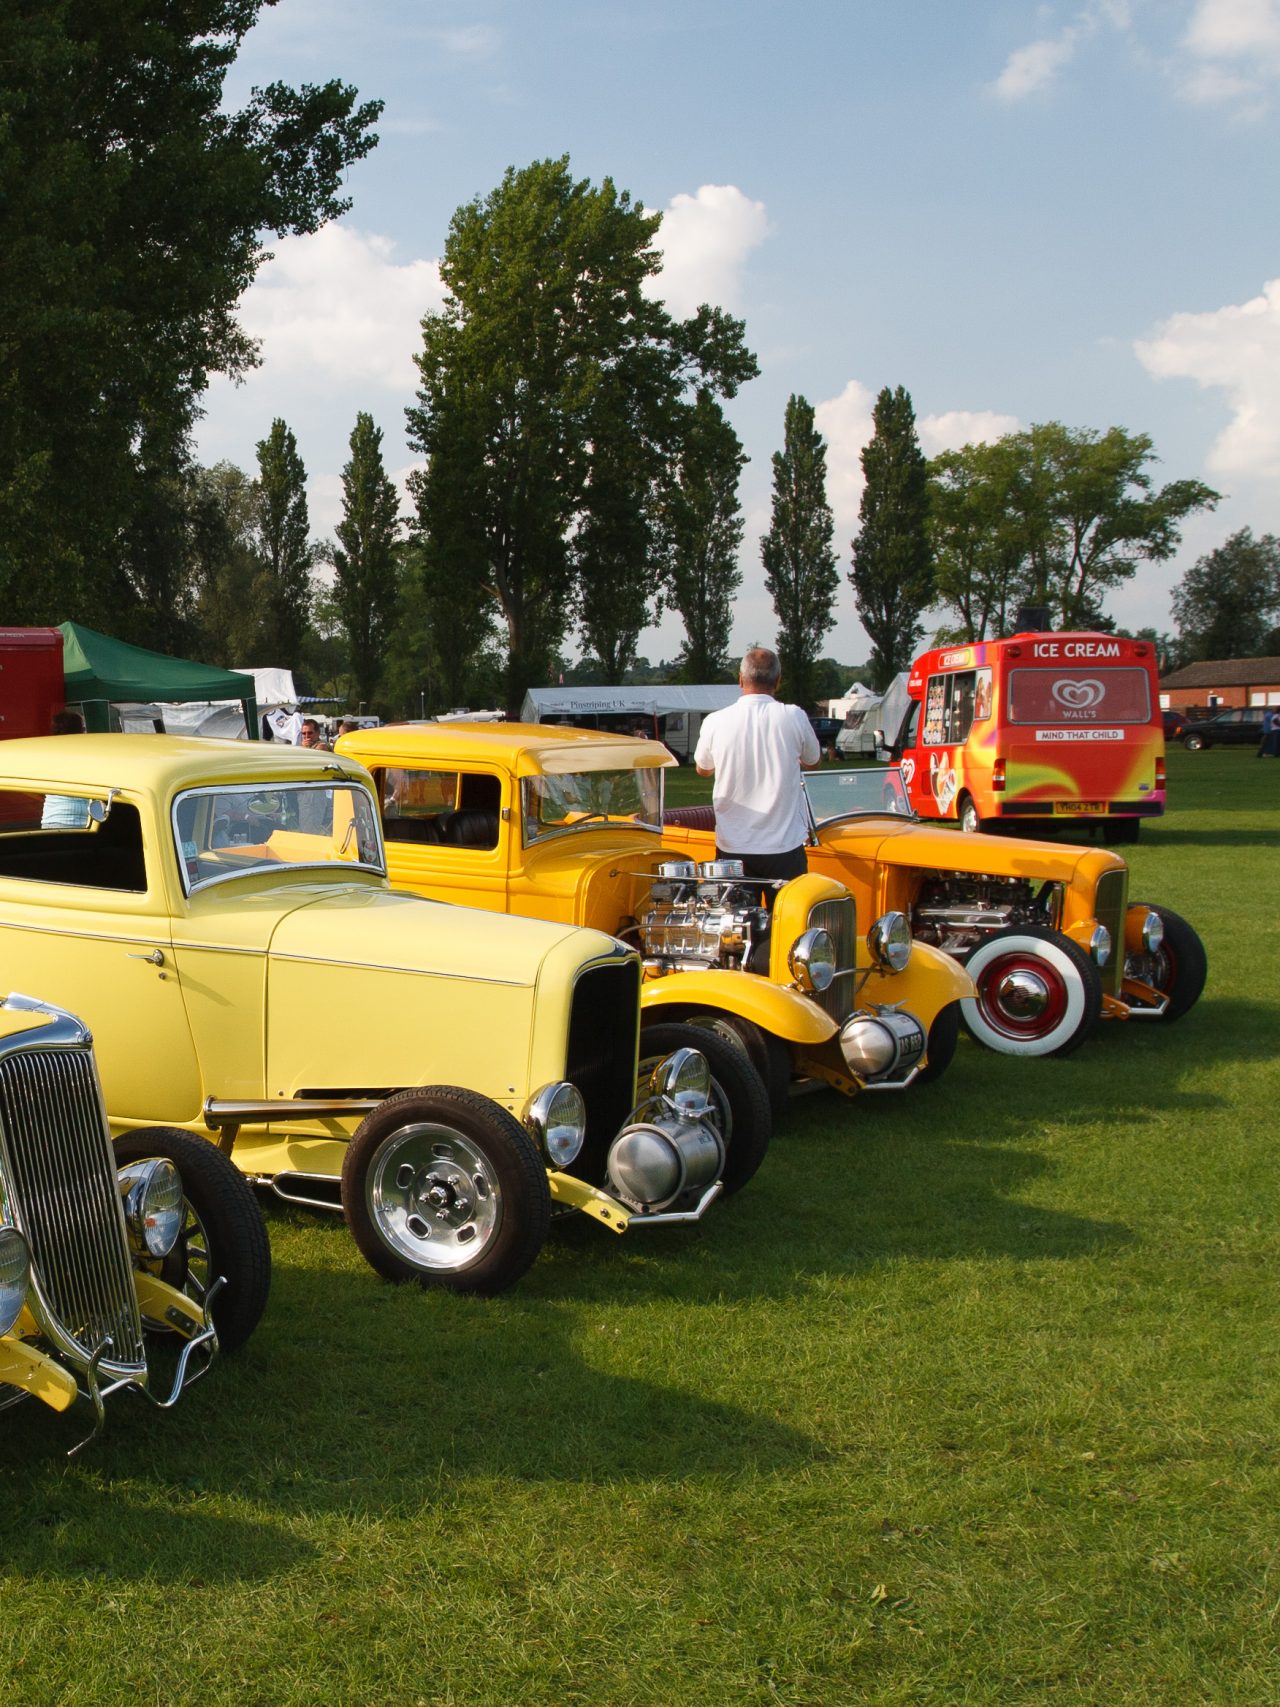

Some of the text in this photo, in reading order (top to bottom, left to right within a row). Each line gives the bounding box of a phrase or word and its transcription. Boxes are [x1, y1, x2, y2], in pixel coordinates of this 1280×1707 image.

[1034, 643, 1120, 657] ICE CREAM
[570, 701, 610, 709] Pinstriping
[613, 700, 625, 708] UK
[1062, 710, 1097, 718] WALL'S
[1041, 730, 1119, 740] MIND THAT CHILD
